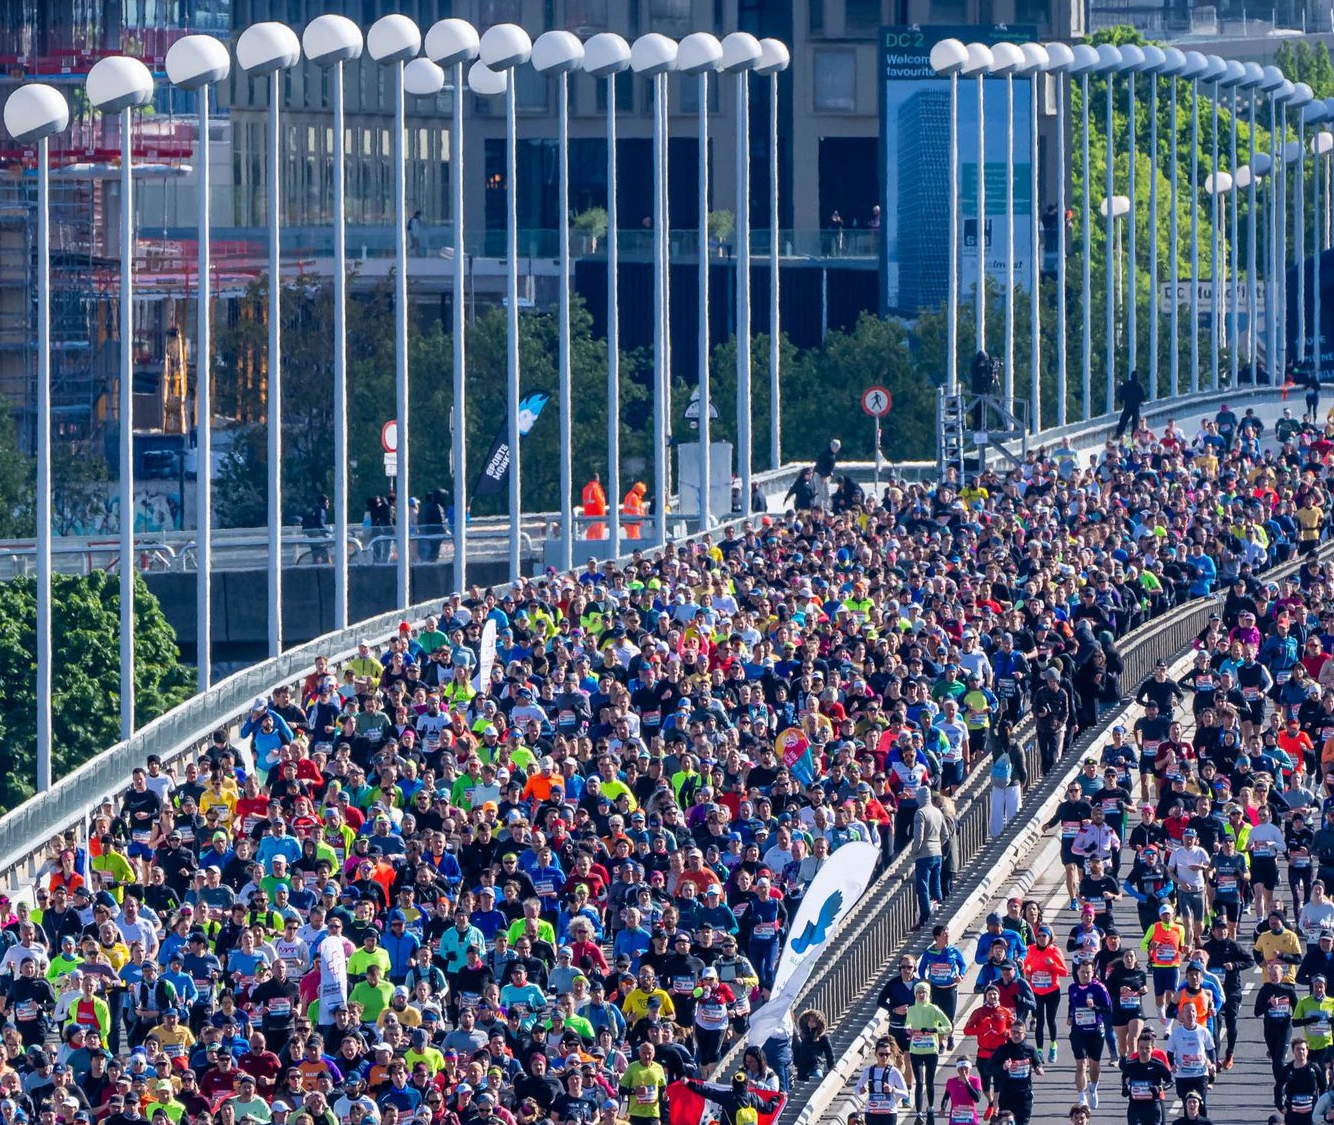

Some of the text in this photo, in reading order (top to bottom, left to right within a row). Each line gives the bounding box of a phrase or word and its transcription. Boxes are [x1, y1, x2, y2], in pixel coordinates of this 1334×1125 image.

[886, 33, 924, 48] DC 2
[886, 54, 931, 64] Welcom
[886, 67, 937, 77] favourite
[485, 443, 509, 477] SPORTS
[492, 450, 510, 481] MONK
